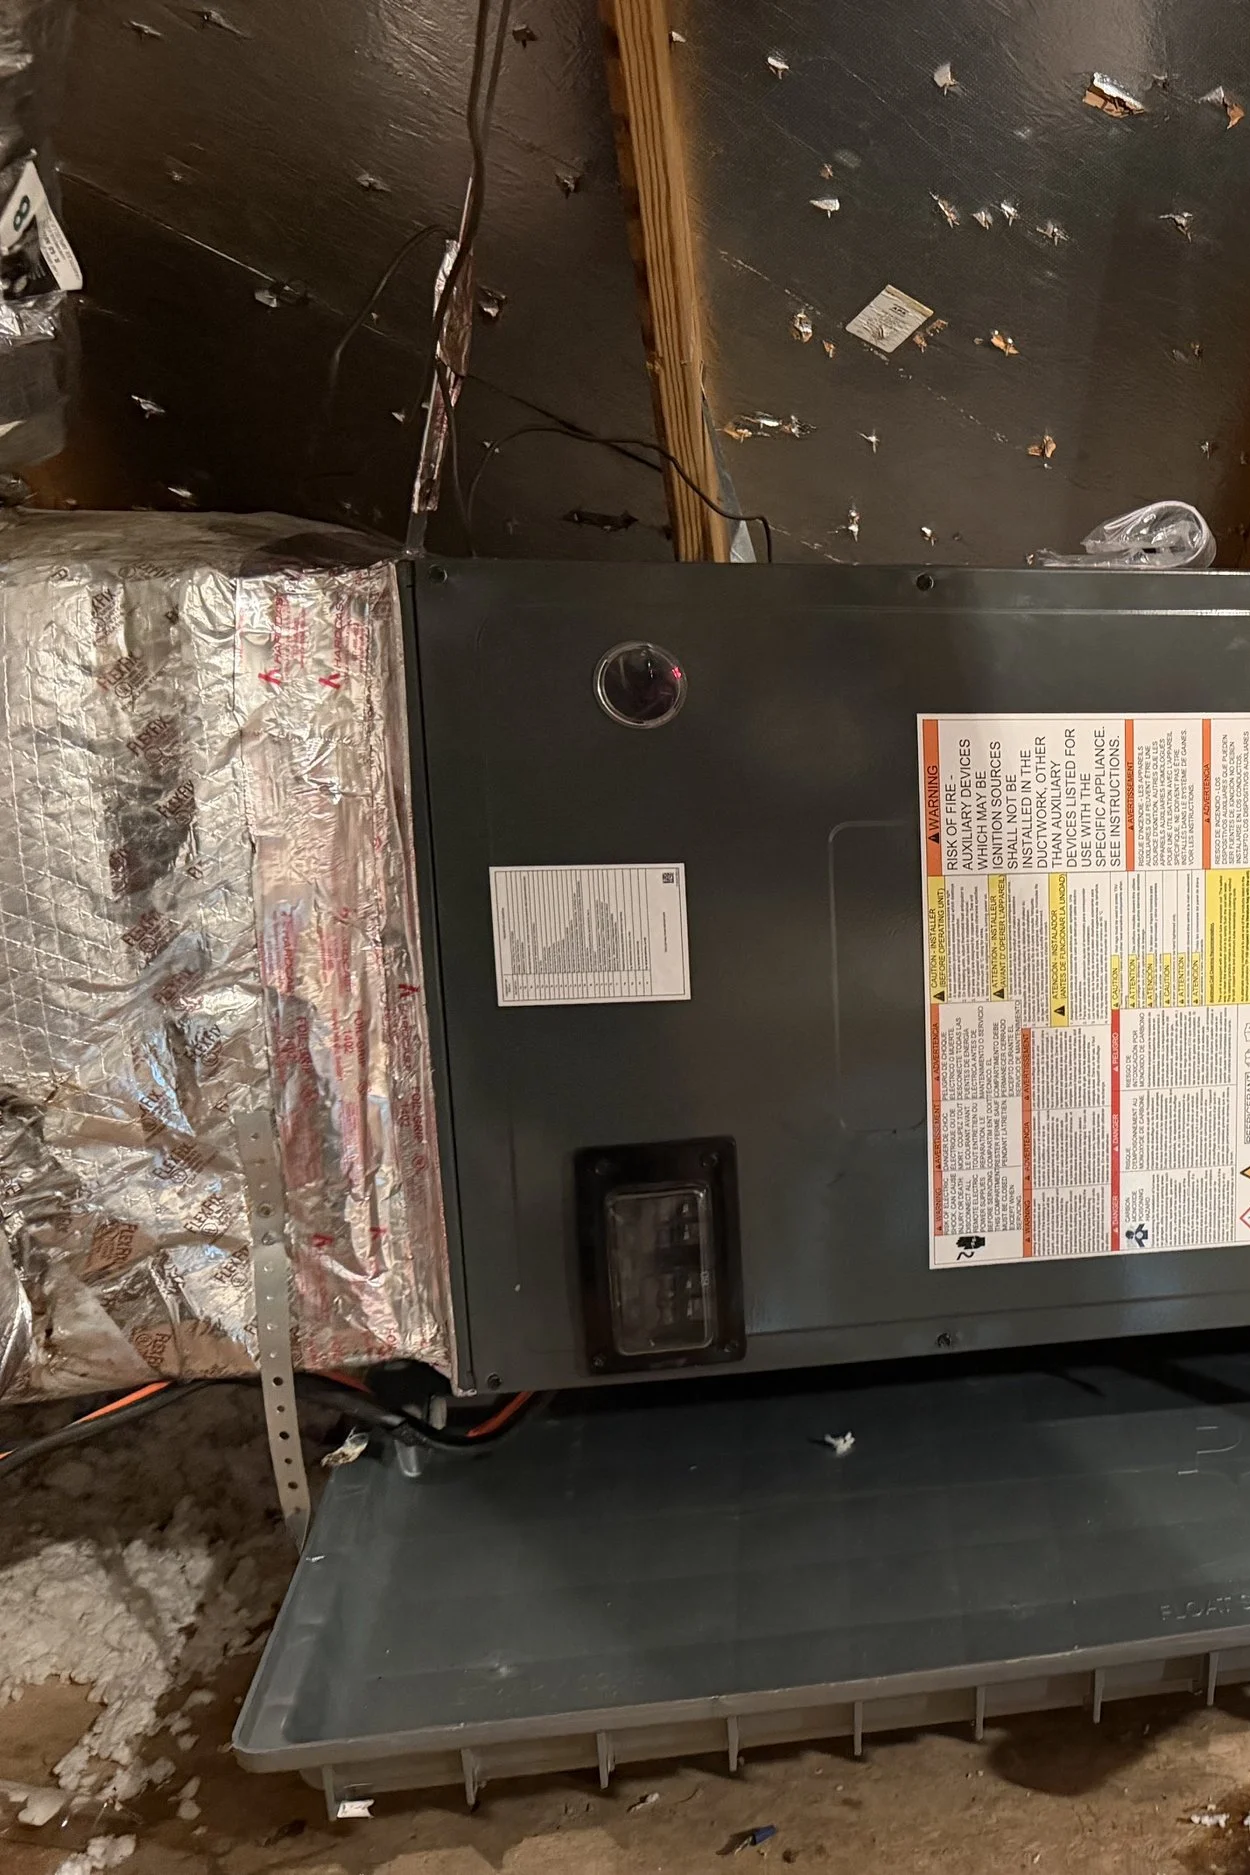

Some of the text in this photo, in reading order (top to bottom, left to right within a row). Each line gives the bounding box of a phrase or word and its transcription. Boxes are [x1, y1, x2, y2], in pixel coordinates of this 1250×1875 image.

[127, 716, 170, 755] FLEXFIX
[157, 780, 194, 818] FLEXFIX
[927, 765, 939, 830] WARNING
[946, 784, 957, 870] RISK OF FIRE
[960, 740, 973, 870] AUXILIARY DEVICES
[976, 771, 988, 870] WHICH MAY BE
[990, 741, 1003, 869] IGNITION SOURCES
[1006, 775, 1018, 869] SHALL NOT BE
[1020, 750, 1032, 868] INSTALLED IN THE
[1035, 737, 1047, 868] DUCTWORK, OTHER
[1050, 760, 1062, 867] THAN AUXILIARY
[1065, 729, 1077, 867] DEVICES LISTED FOR
[1080, 773, 1091, 867] USE WITH THE
[1094, 727, 1106, 867] SPECIFIC APPLIANCE.
[1109, 736, 1120, 867] SEE INSTRUCTIONS.
[1058, 918, 1066, 960] FUNCIONAR
[1059, 906, 1065, 916] LA
[1059, 977, 1067, 999] (ANTES
[1060, 964, 1066, 974] DE
[412, 1086, 424, 1143] FOIL-GRIP
